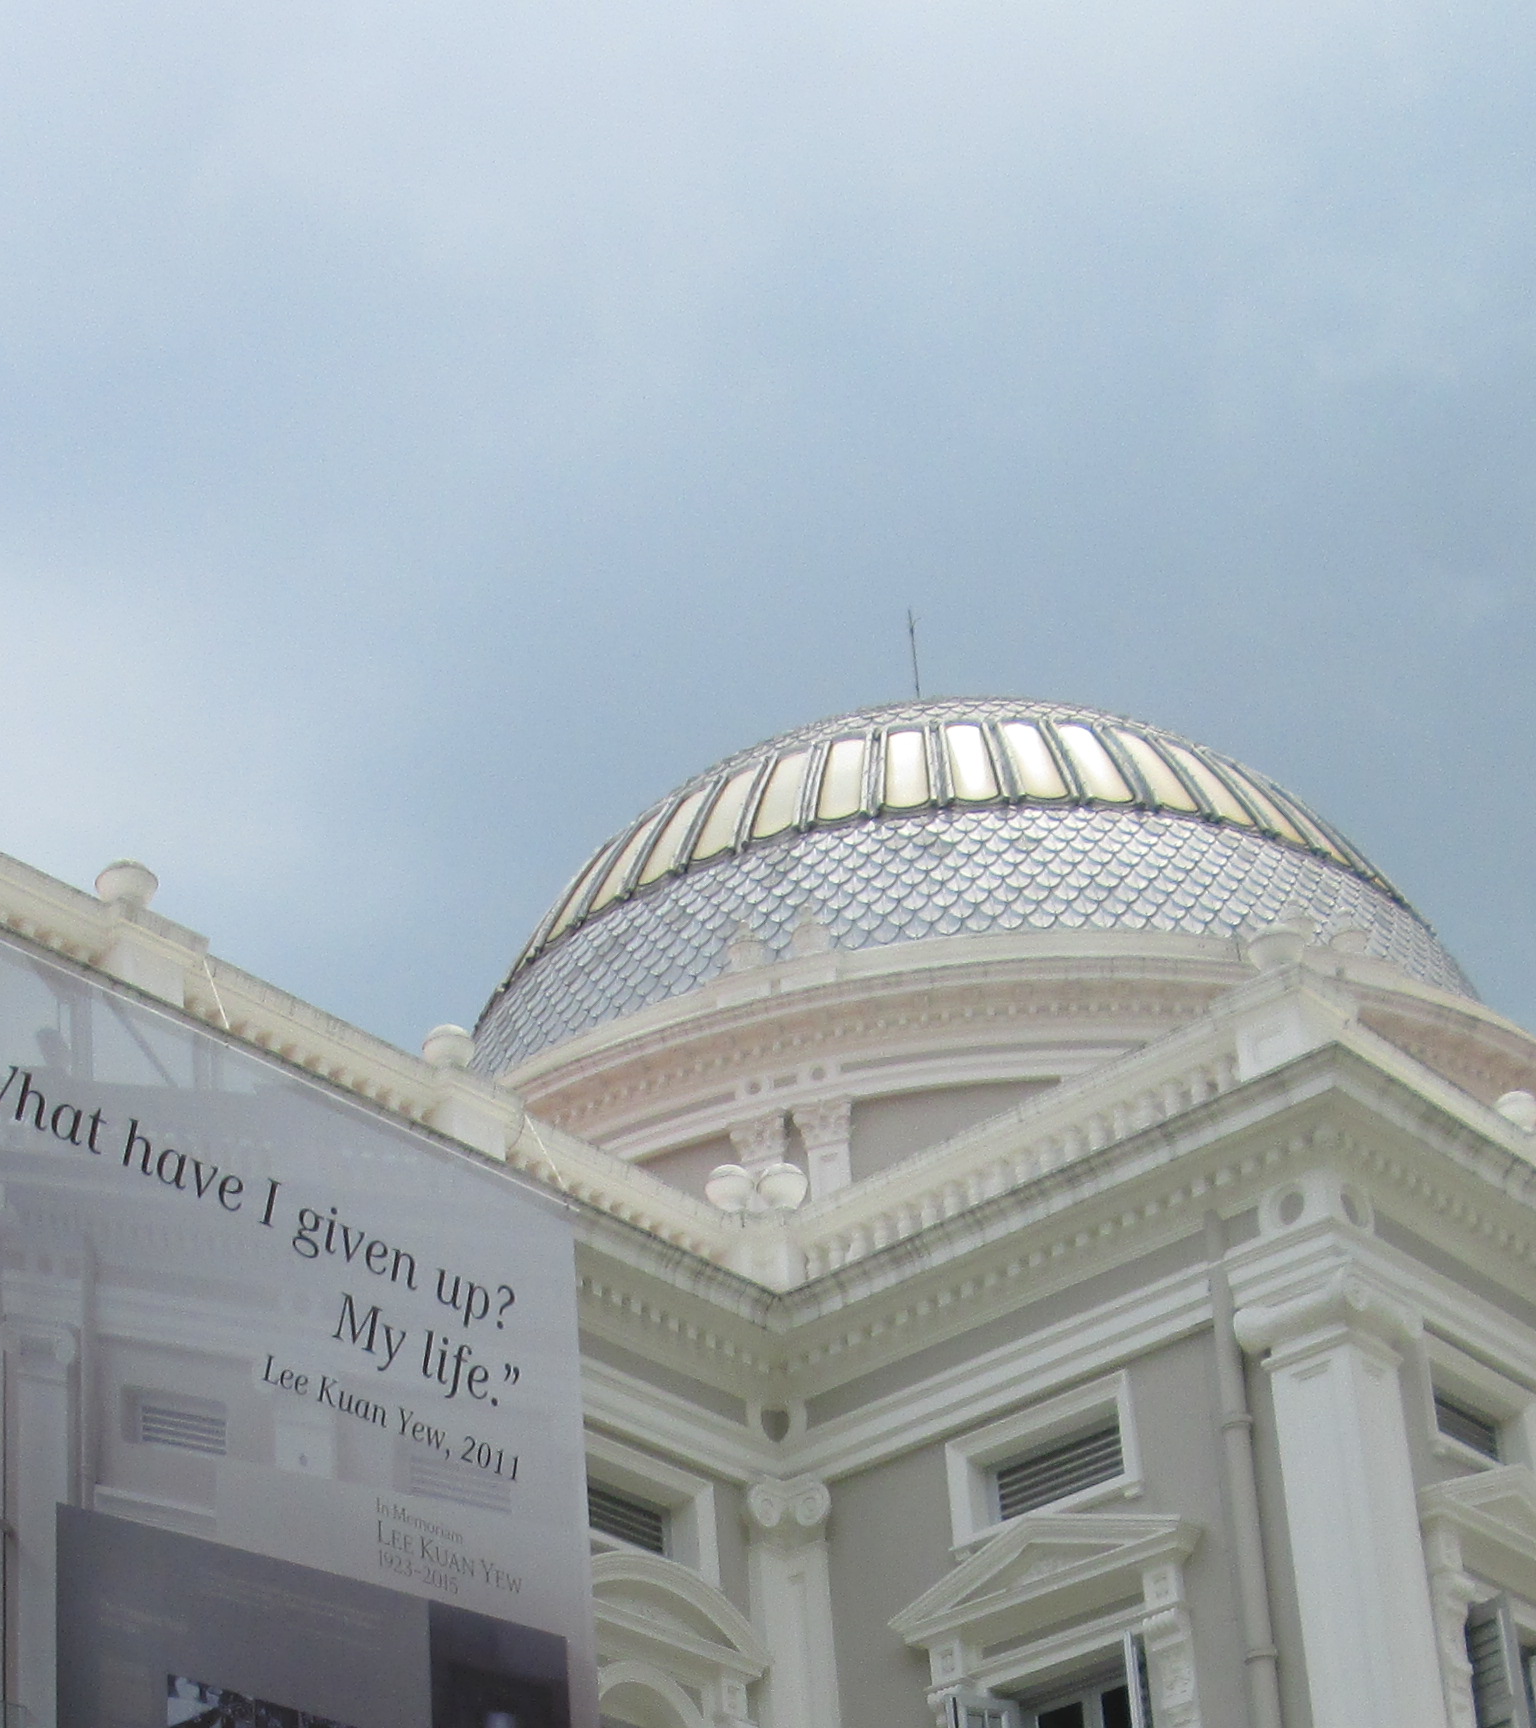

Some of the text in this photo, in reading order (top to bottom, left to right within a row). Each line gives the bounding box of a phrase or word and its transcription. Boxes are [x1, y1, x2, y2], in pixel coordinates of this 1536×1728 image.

[122, 1117, 245, 1212] have
[259, 1177, 282, 1228] I
[291, 1206, 418, 1291] given
[435, 1267, 516, 1330] up?
[331, 1291, 521, 1407] My life.”
[262, 1353, 520, 1480] Lee Kuan Yew, 2011
[376, 1496, 464, 1545] In Memoriam
[377, 1519, 523, 1594] LEE KUAN YEW
